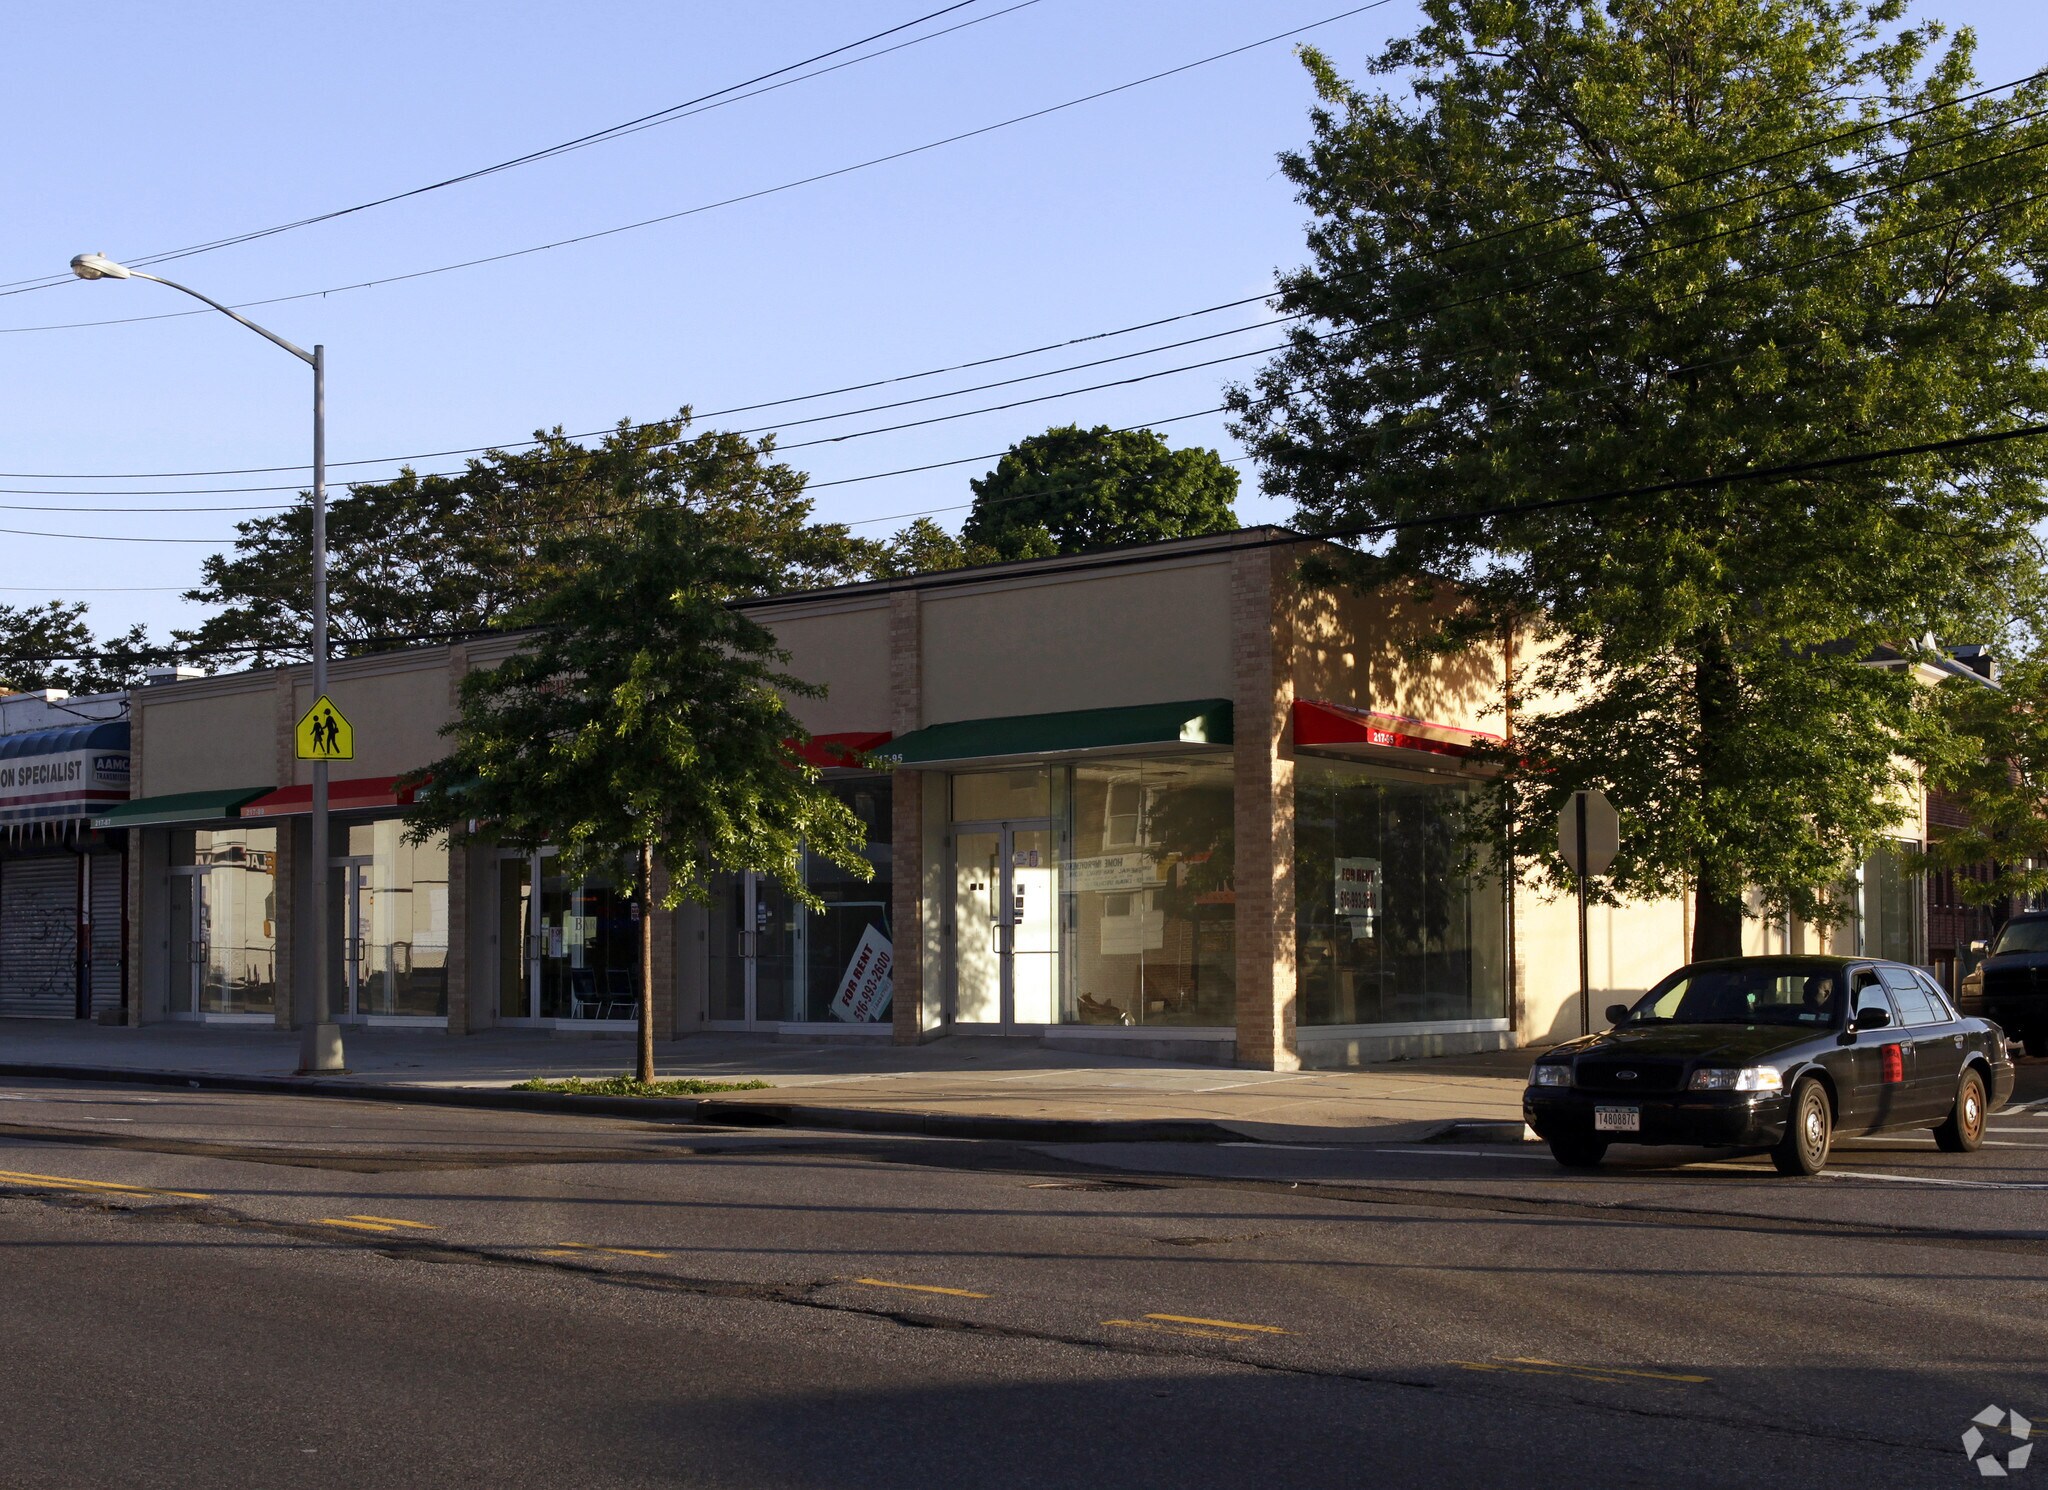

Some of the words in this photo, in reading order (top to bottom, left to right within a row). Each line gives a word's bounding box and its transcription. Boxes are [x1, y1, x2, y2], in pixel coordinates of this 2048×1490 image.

[97, 758, 130, 770] AAMC
[19, 761, 82, 786] SPECIALIST
[1342, 868, 1355, 881] FOR
[1357, 869, 1375, 882] RENT
[841, 979, 858, 1008] FOR
[853, 943, 873, 981] RENT
[1599, 1113, 1636, 1125] T480887C
